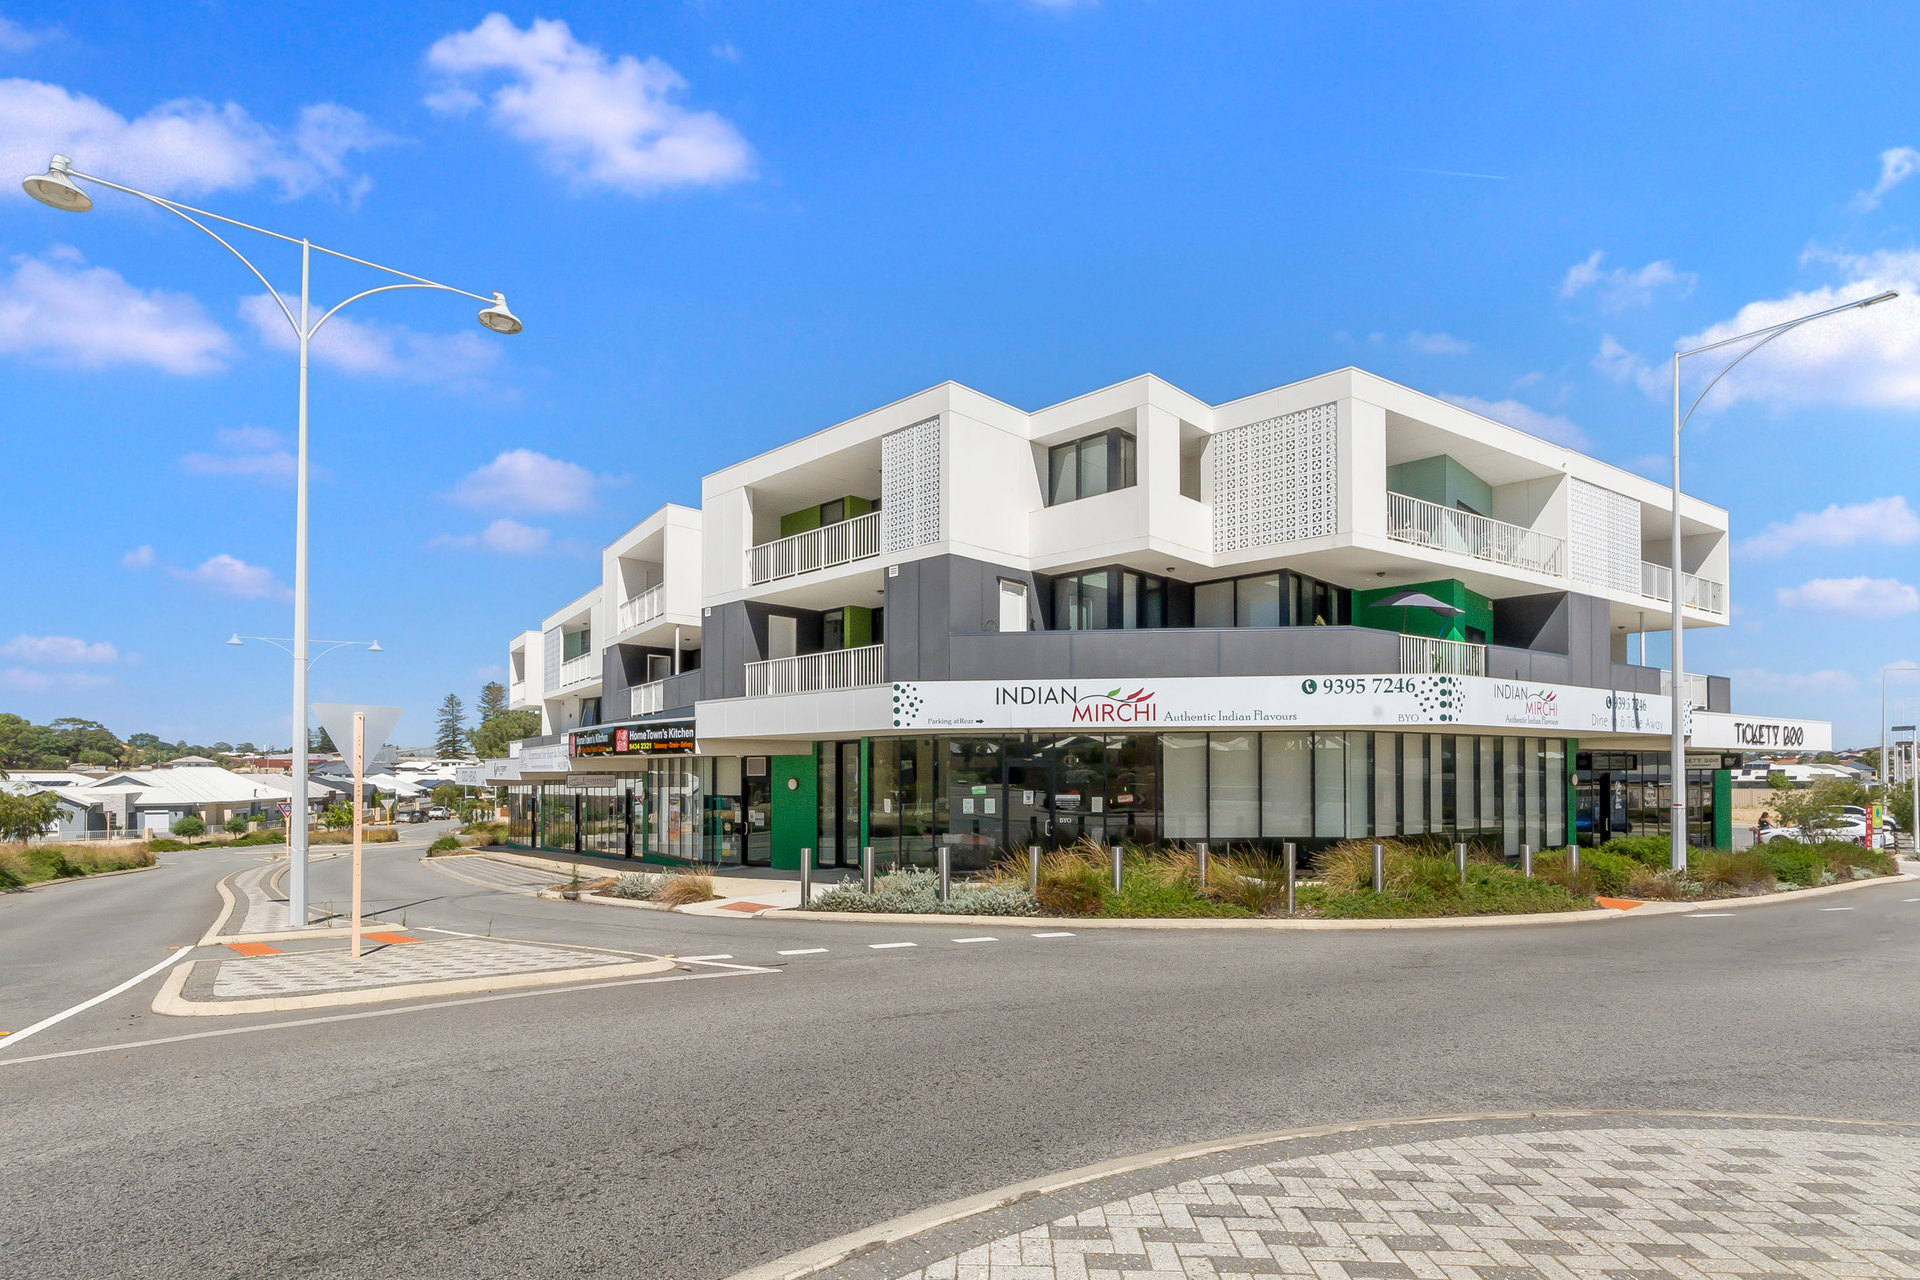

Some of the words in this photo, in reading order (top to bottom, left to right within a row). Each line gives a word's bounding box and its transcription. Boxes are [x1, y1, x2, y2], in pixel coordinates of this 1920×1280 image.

[1323, 678, 1366, 694] 9395
[1372, 677, 1416, 694] 7246
[1494, 684, 1528, 700] INDIAN
[996, 686, 1077, 705] INDIAN
[1072, 703, 1156, 722] MIRCHI
[1164, 711, 1216, 721] Authentic
[1218, 710, 1251, 721] Indian
[1253, 709, 1297, 721] Flavours
[1525, 701, 1558, 716] MIRCHI
[927, 718, 952, 726] Parking
[1398, 714, 1419, 722] BYO
[1505, 714, 1527, 724] Authentic
[1592, 713, 1608, 727] Dine
[1621, 716, 1626, 728] &
[1627, 716, 1642, 729] Tae
[1645, 718, 1663, 732] Away
[668, 728, 694, 739] Kitchen
[1783, 726, 1804, 747] BOO
[640, 742, 652, 750] 2321
